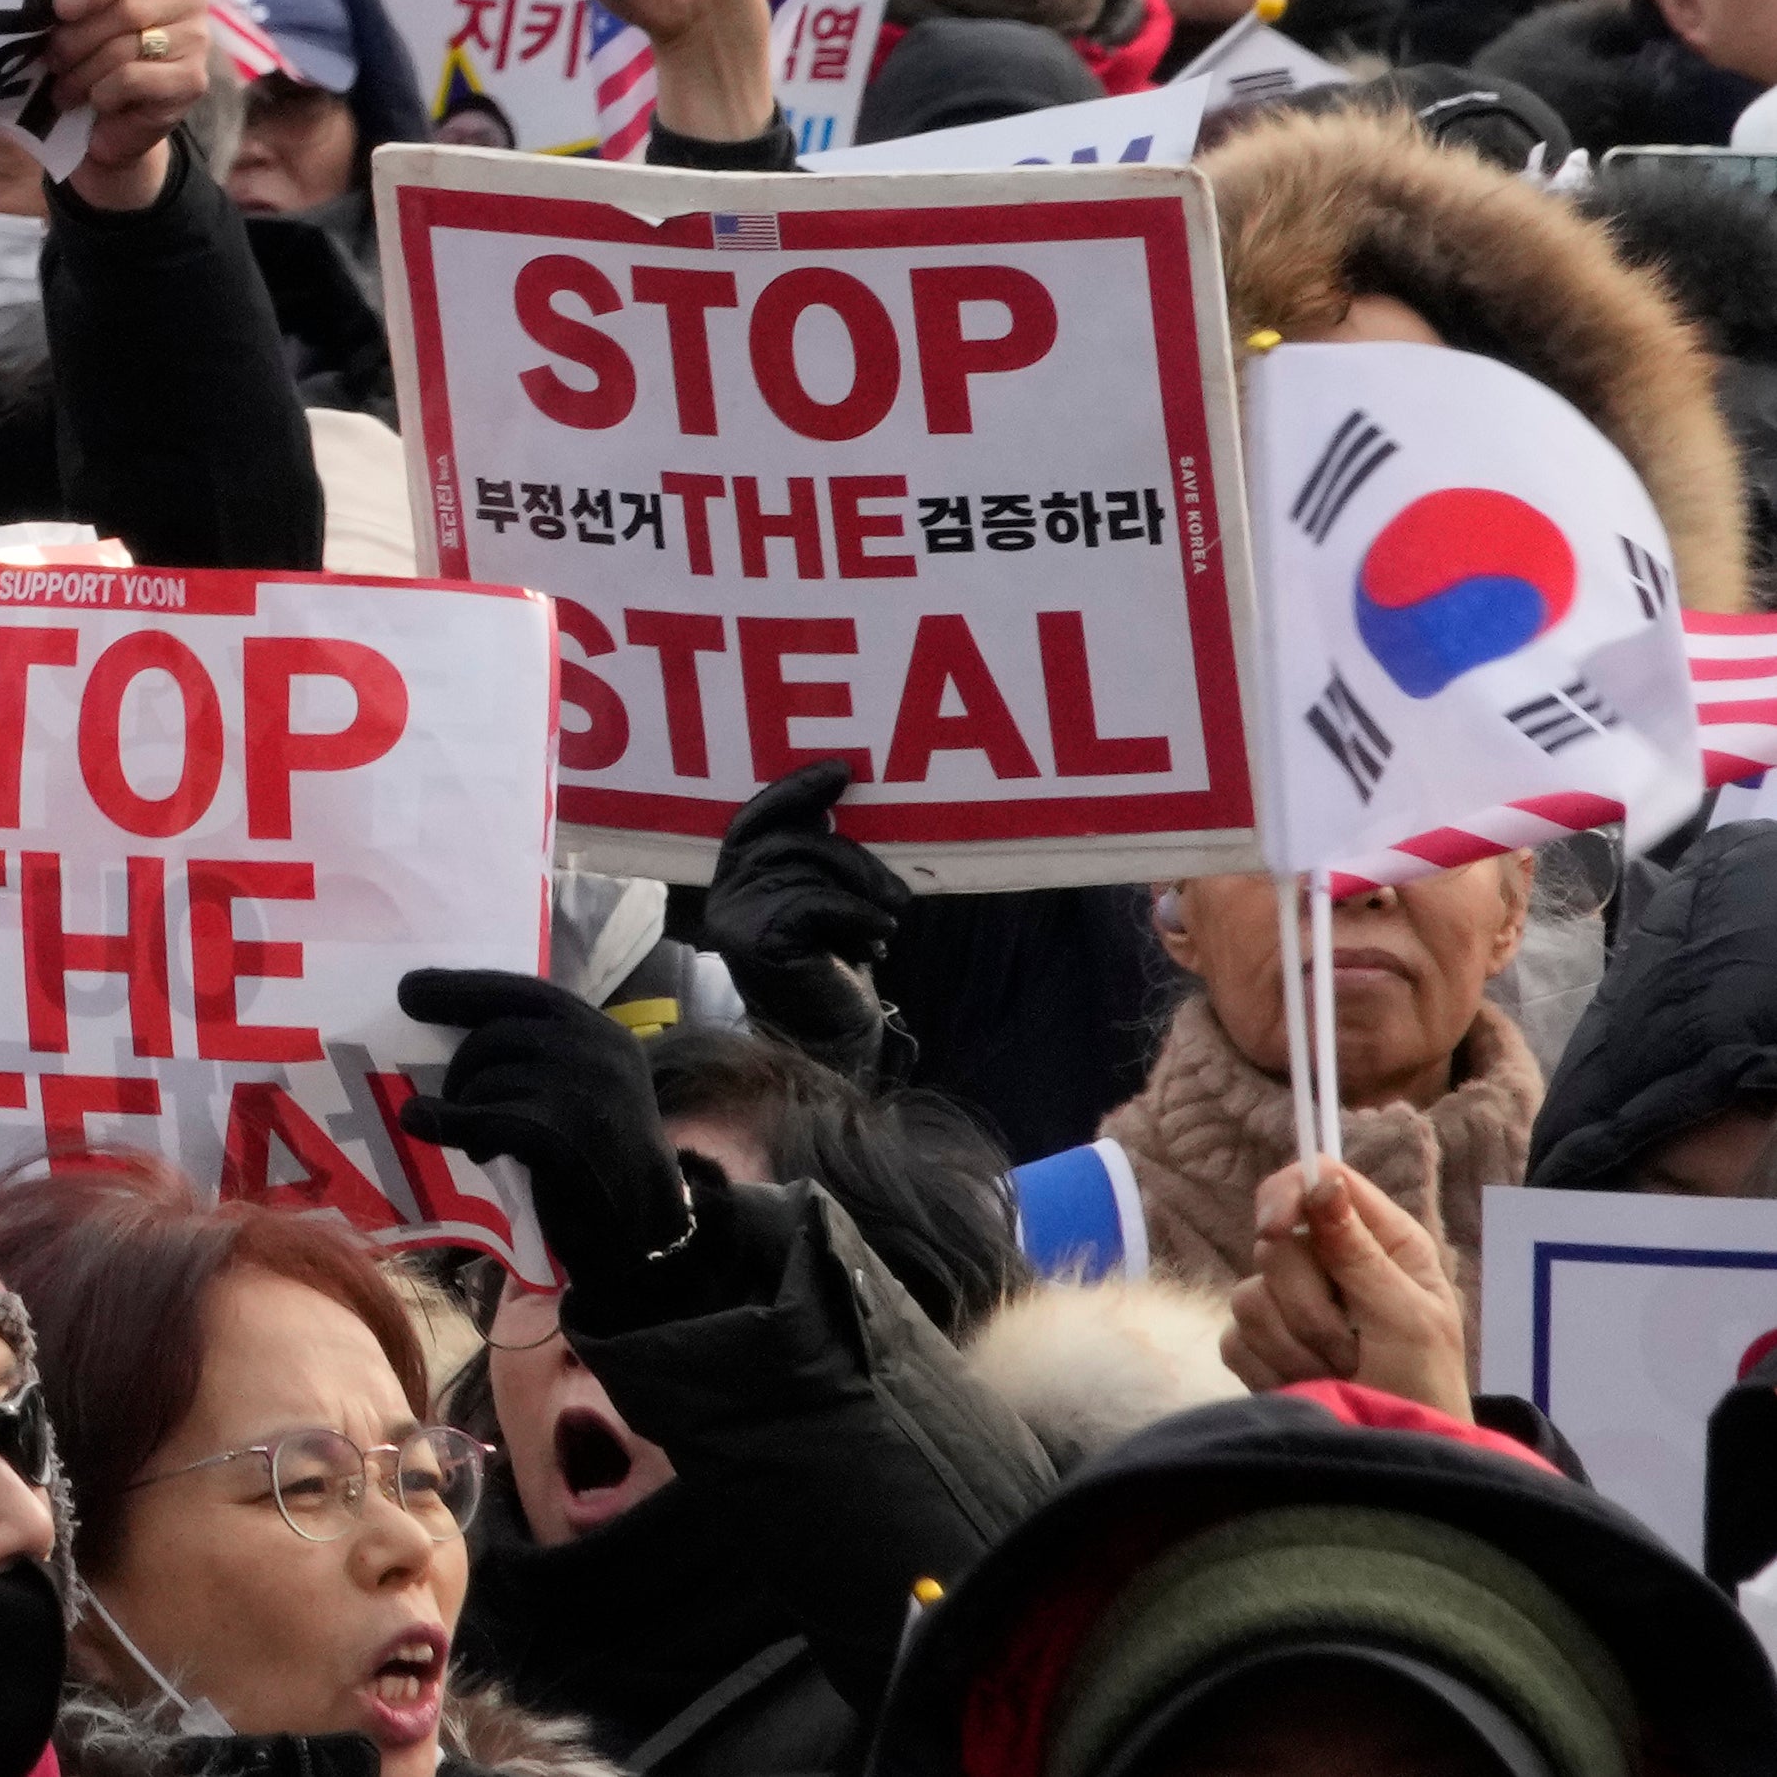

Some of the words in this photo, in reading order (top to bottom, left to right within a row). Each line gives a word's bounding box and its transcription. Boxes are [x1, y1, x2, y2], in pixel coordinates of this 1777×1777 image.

[513, 253, 1059, 442] STOP
[474, 476, 666, 551] 부정선거
[1179, 456, 1201, 504] SAVE
[660, 471, 917, 580] THE
[917, 488, 1165, 554] 검증하라
[1186, 510, 1208, 574] KOREA
[122, 572, 187, 608] YOON
[555, 596, 1172, 783] STEAL
